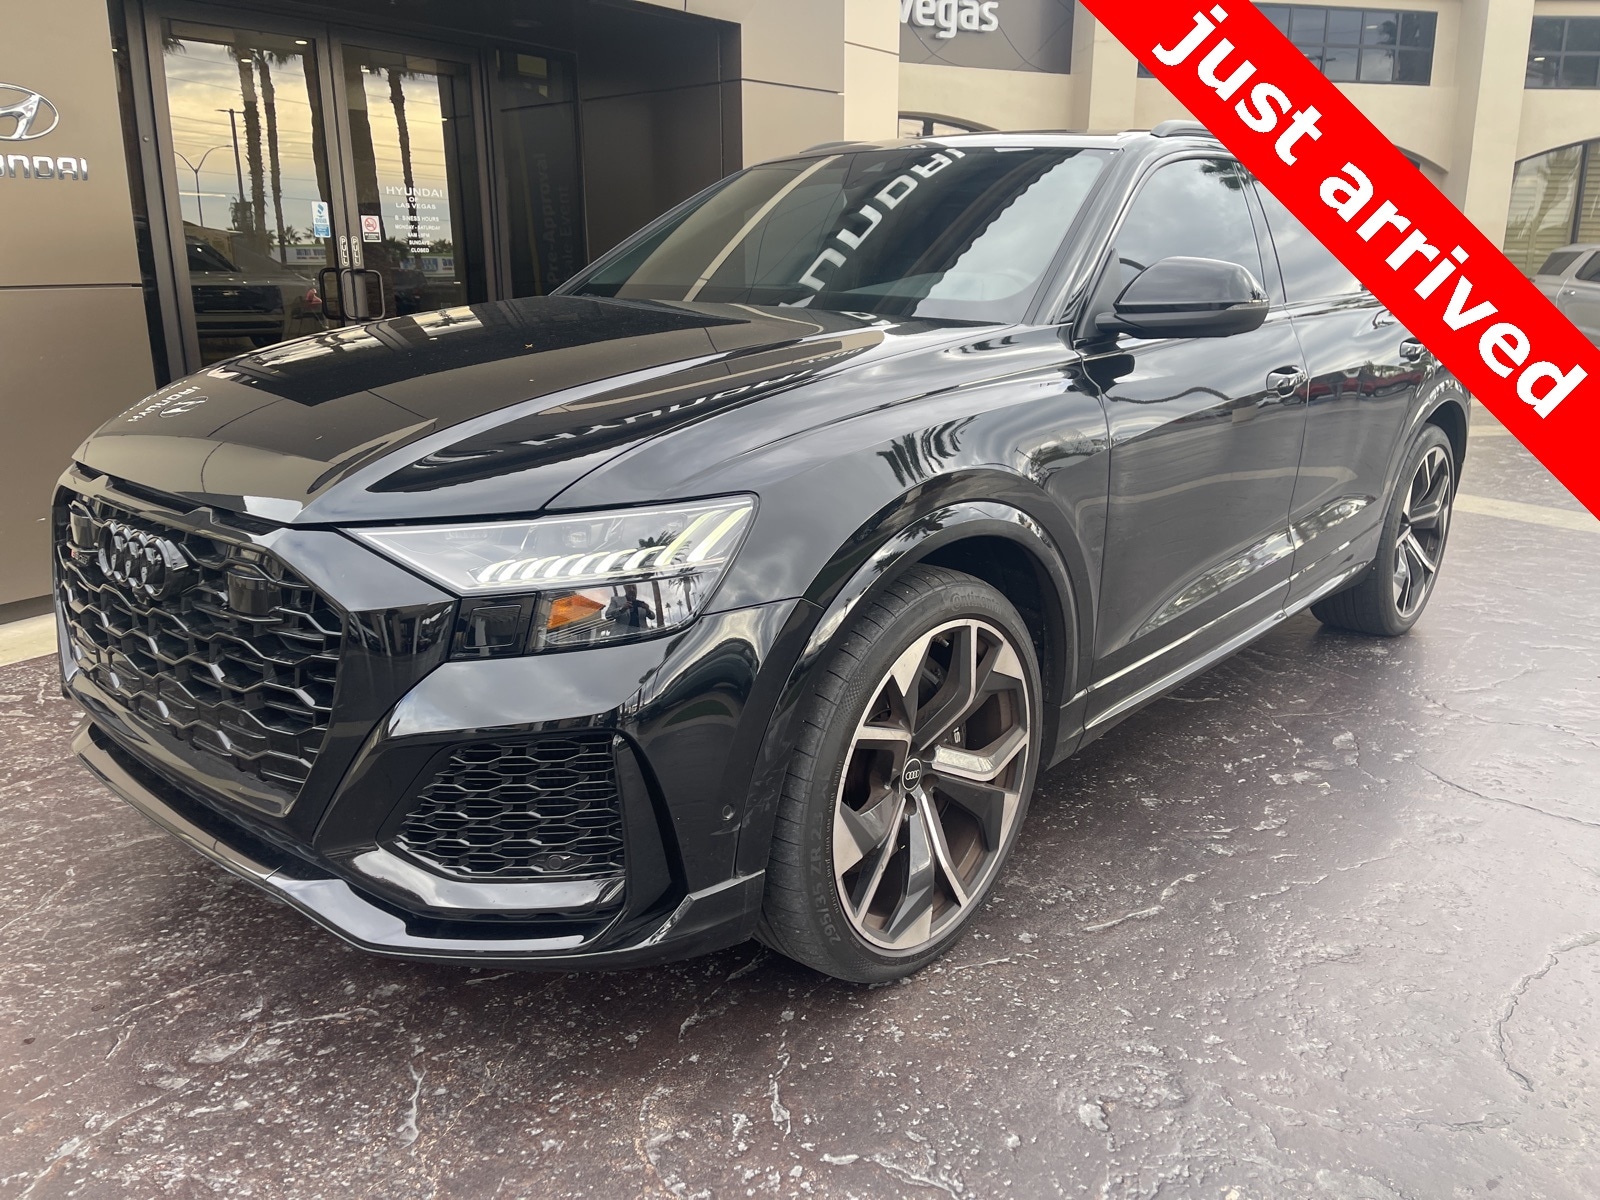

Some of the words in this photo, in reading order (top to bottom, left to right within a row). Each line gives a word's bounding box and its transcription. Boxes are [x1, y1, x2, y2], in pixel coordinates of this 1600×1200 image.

[385, 186, 443, 197] HYUNDAI
[533, 153, 559, 283] Pre-Approval
[810, 846, 823, 877] ZR
[812, 882, 842, 946] 295/35
